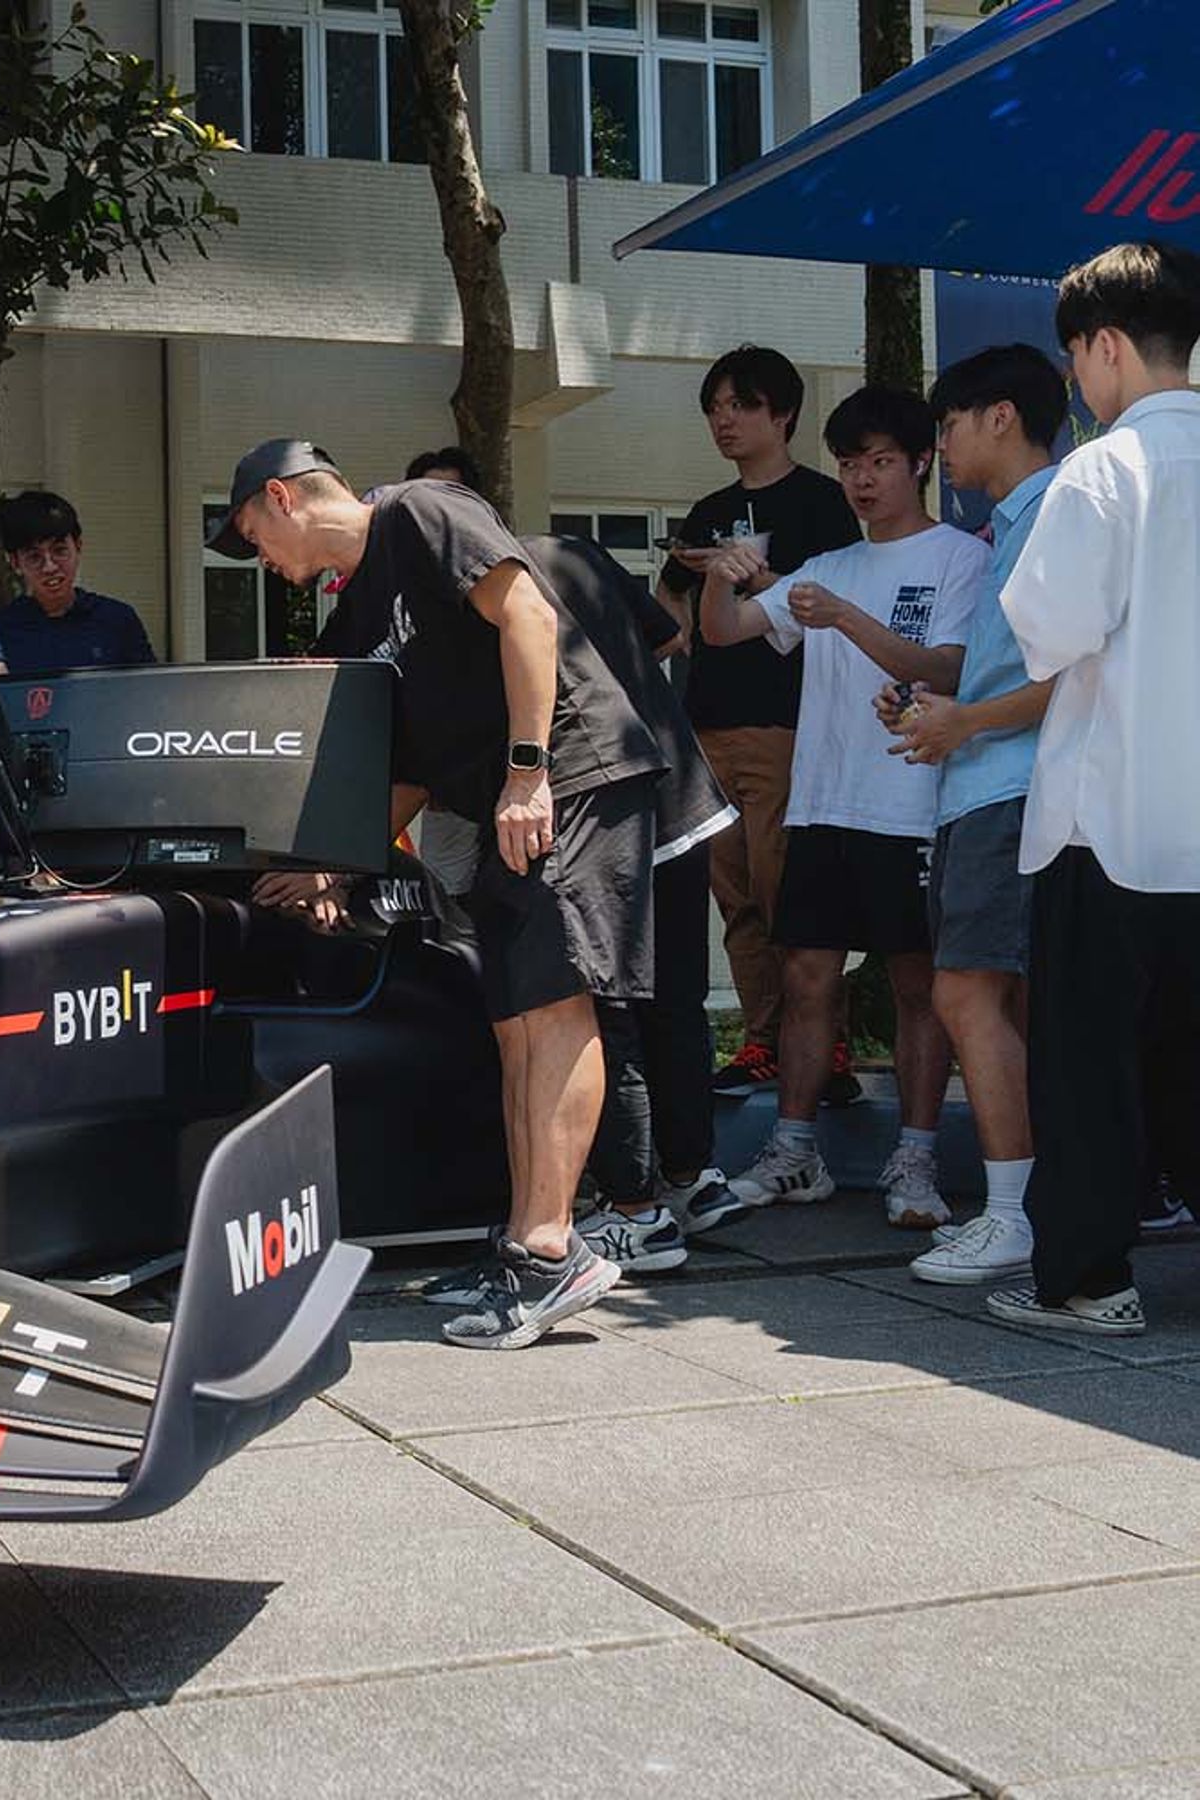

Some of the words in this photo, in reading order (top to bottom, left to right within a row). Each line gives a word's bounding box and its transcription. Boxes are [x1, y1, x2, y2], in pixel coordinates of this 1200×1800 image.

[127, 730, 303, 757] ORACLE
[54, 969, 152, 1045] BYBIT
[225, 1184, 319, 1296] Mobil
